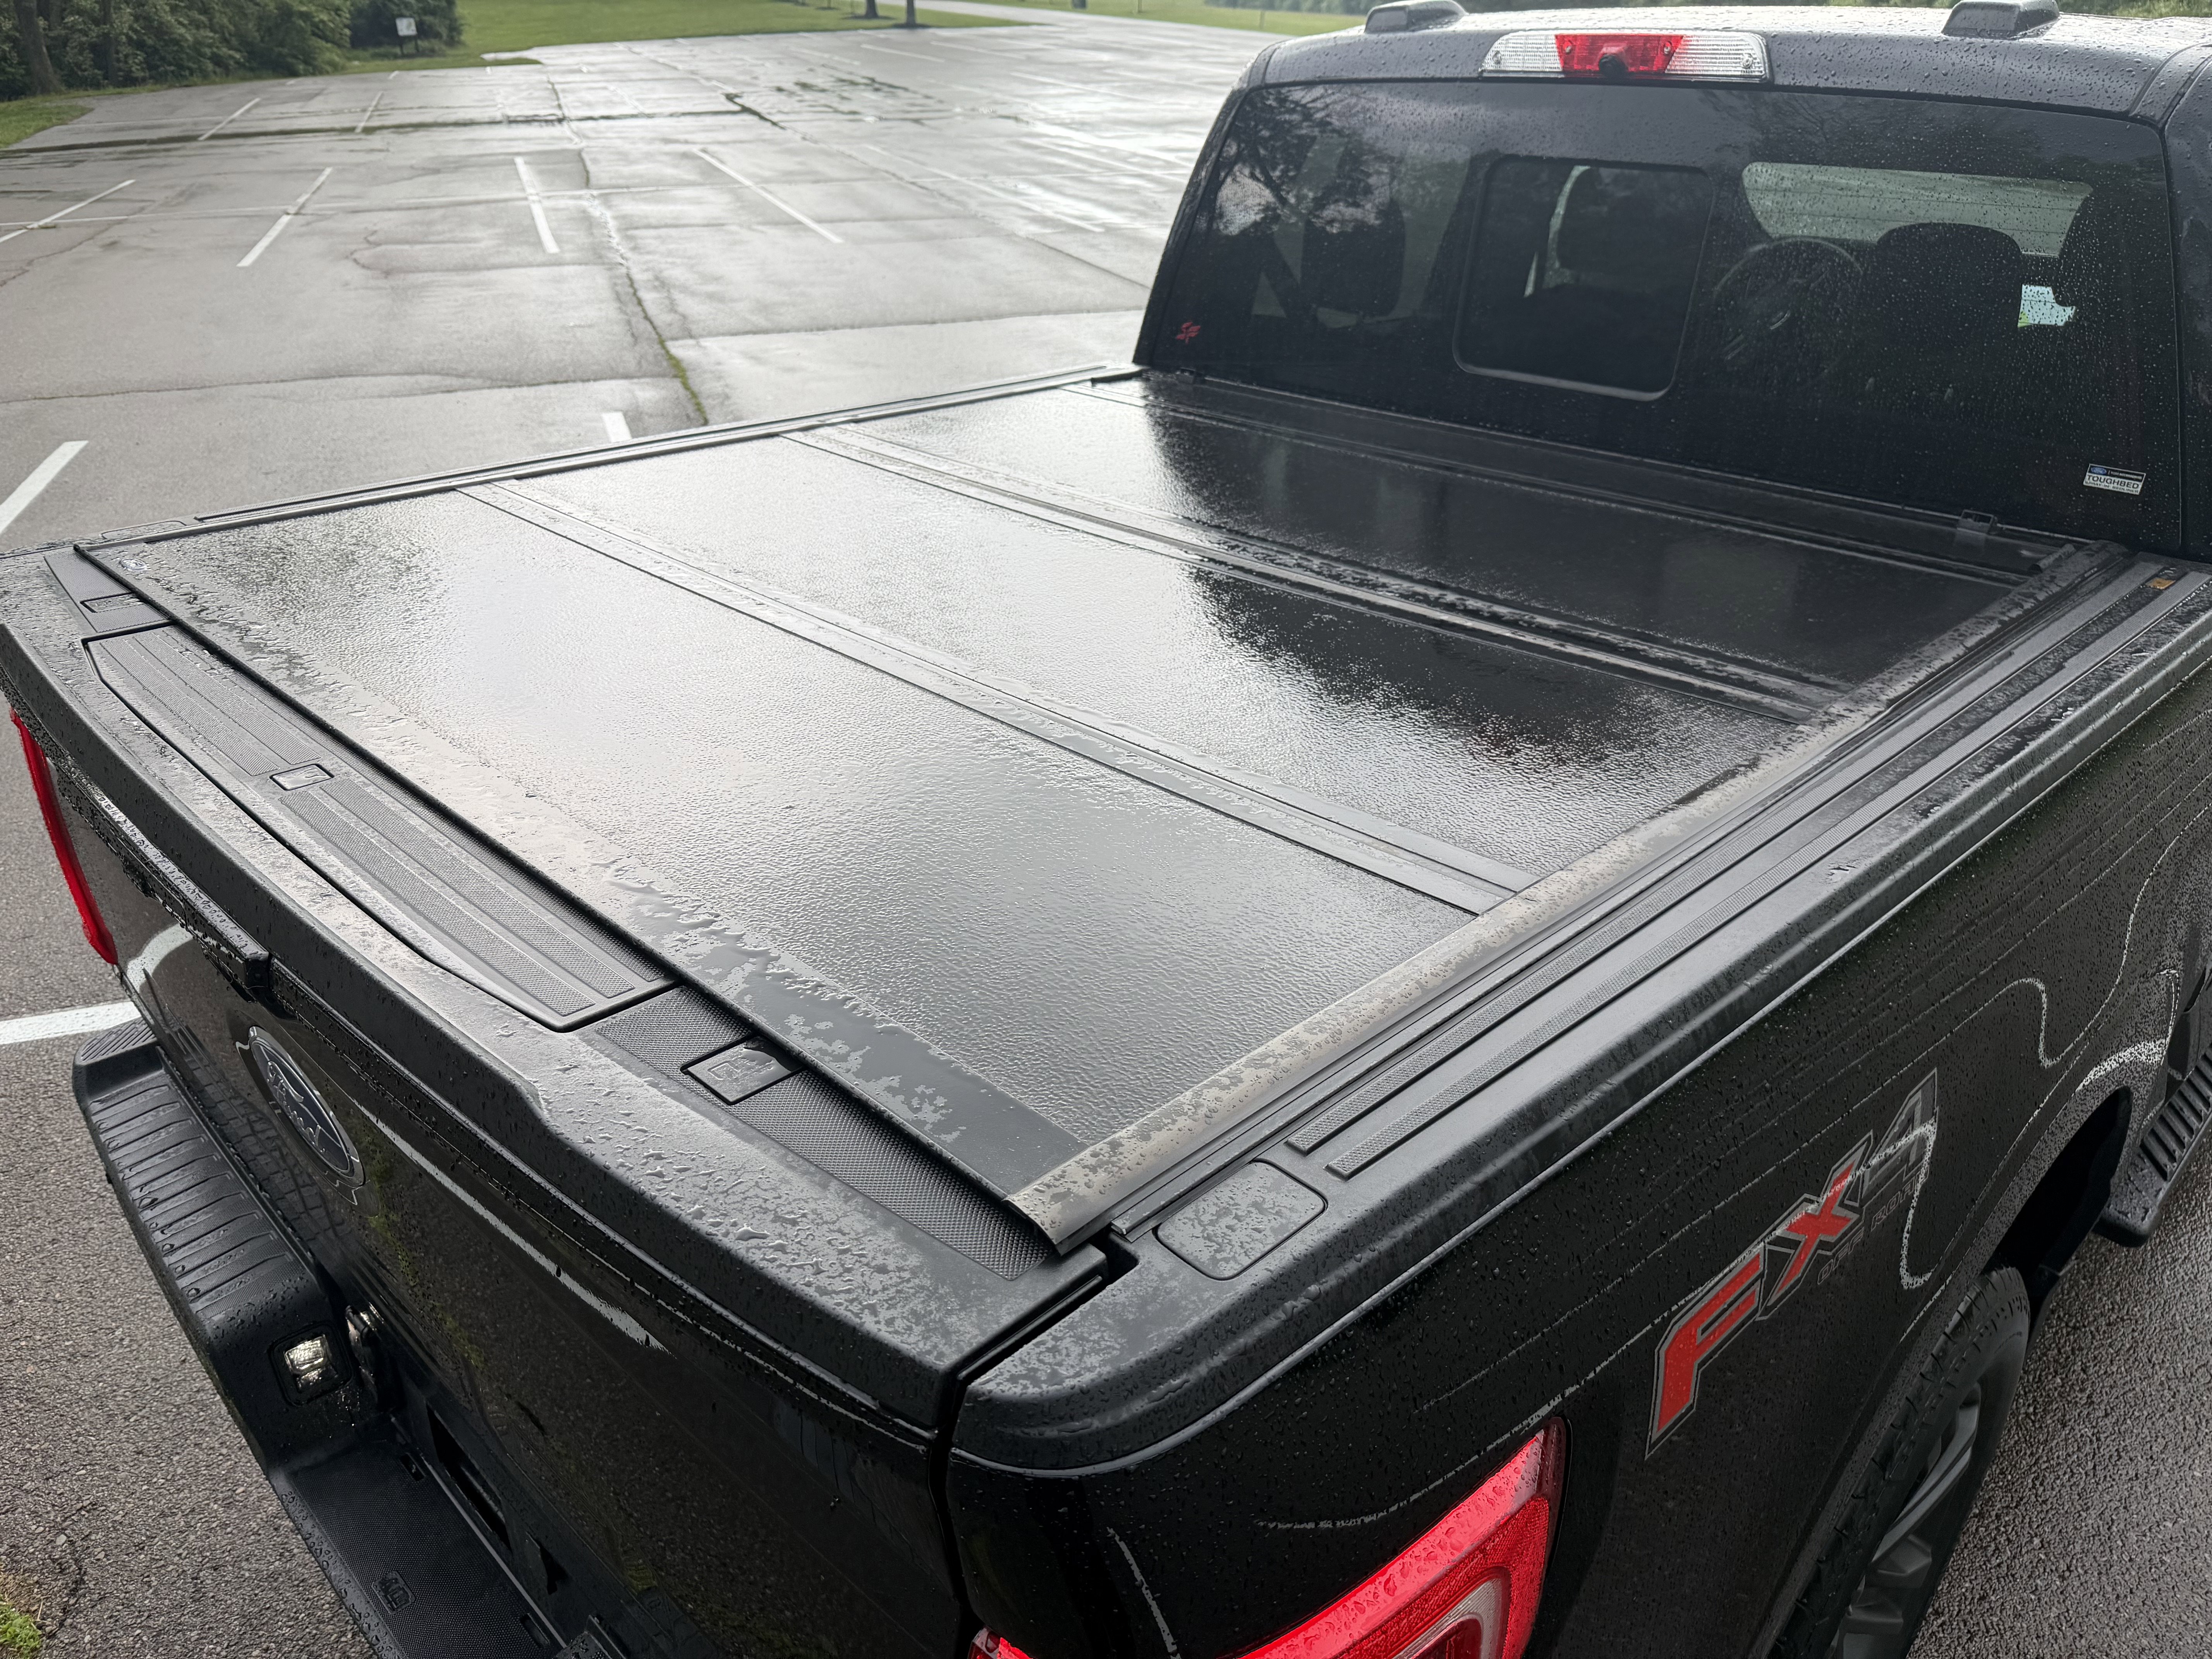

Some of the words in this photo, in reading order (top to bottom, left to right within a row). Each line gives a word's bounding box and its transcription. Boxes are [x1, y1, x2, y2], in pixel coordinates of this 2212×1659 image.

[2087, 474, 2139, 489] TOUGHBED
[1645, 1067, 1938, 1460] FX4
[1817, 1226, 1865, 1285] OFF
